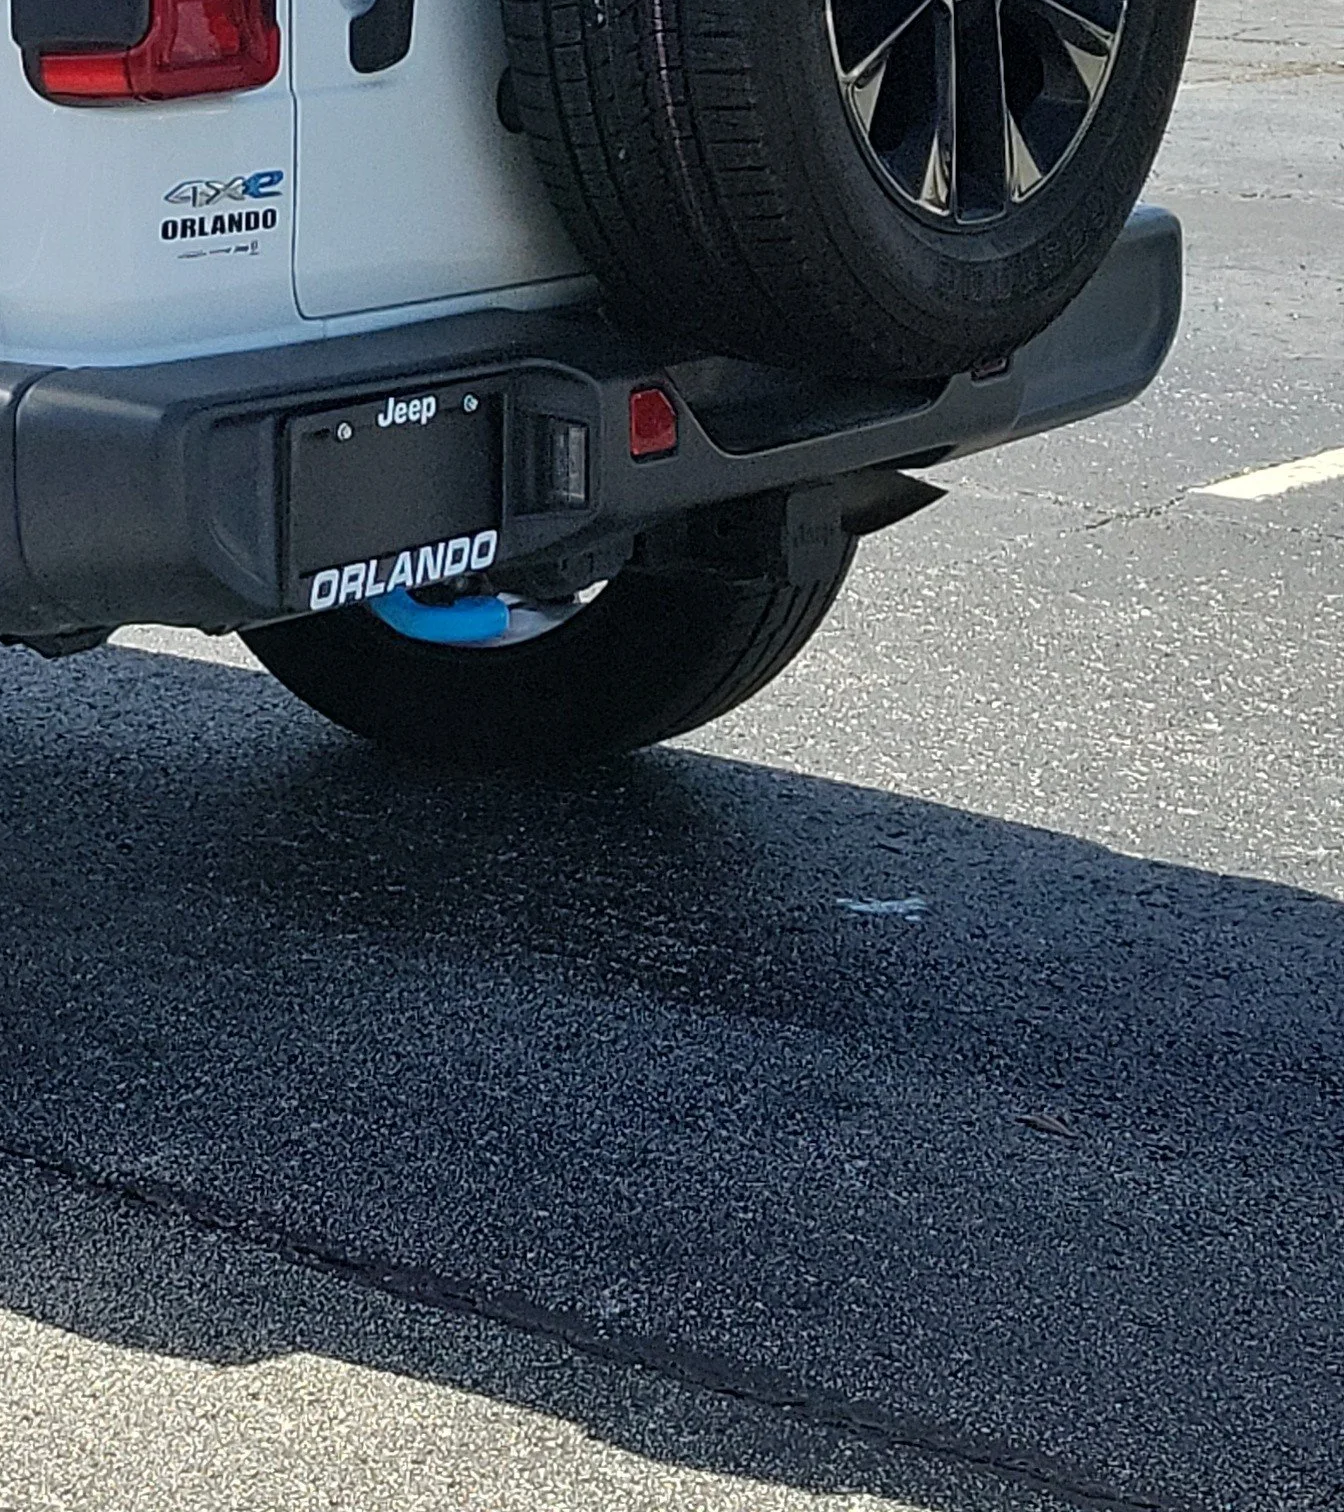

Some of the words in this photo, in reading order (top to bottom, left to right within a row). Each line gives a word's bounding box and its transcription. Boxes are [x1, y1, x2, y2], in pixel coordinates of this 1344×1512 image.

[161, 208, 277, 240] ORLANDO
[377, 395, 437, 427] Jeep
[309, 529, 498, 610] ORLANDO
